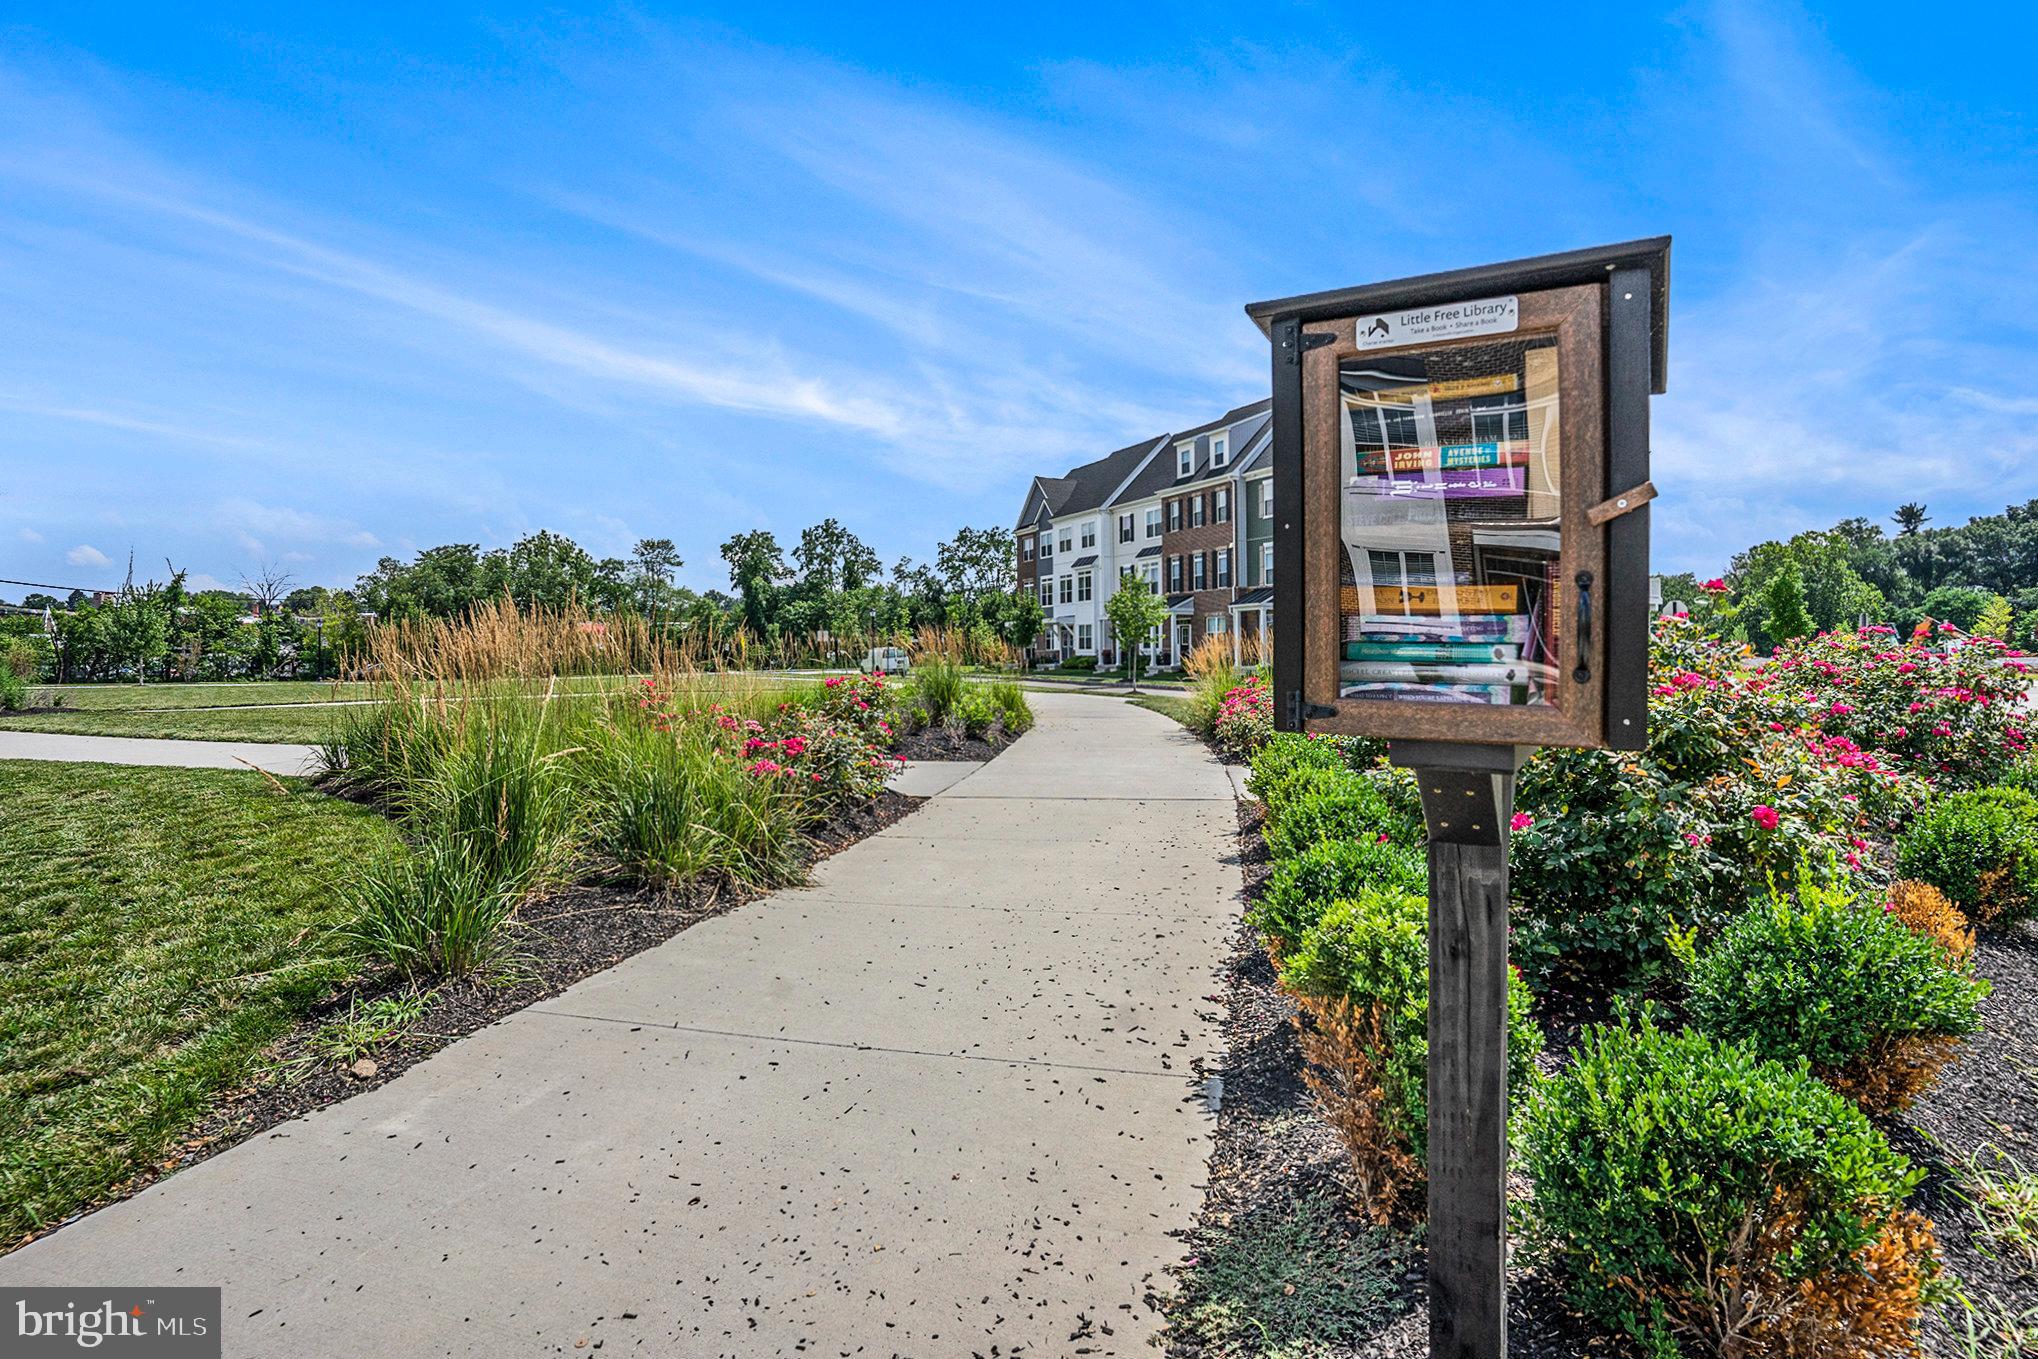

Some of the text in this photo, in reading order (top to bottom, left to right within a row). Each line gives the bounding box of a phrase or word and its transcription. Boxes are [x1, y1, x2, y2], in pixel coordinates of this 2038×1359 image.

[1400, 304, 1507, 326] Little Free Library
[1431, 324, 1447, 332] Book
[1455, 321, 1474, 329] Share
[1395, 450, 1432, 460] JOHN
[1448, 447, 1483, 456] AVENUE
[1394, 459, 1432, 469] IRVING
[1448, 455, 1490, 465] MYSTERIES
